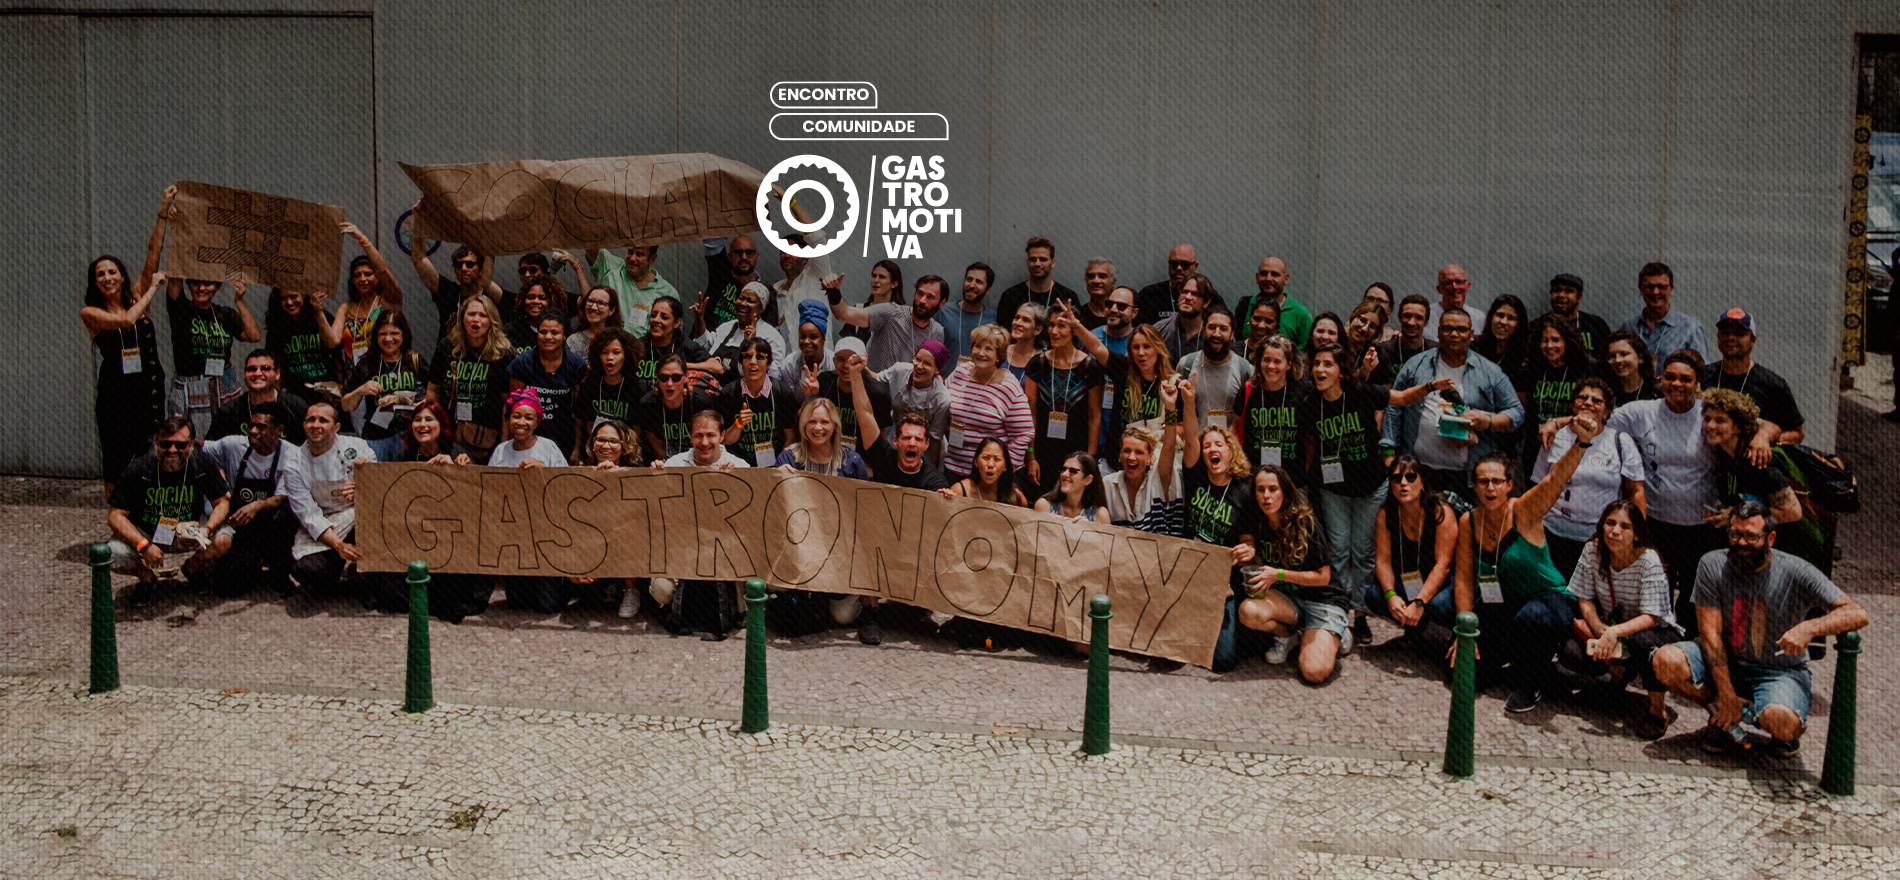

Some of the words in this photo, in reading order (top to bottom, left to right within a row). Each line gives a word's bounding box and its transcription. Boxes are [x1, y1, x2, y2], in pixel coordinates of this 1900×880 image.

[284, 333, 323, 354] SOCIAL
[1250, 407, 1298, 428] SOCIAL
[1315, 411, 1365, 442] SOCIAL
[144, 484, 195, 507] SOCIAL
[381, 468, 1209, 652] GASTRONOMY
